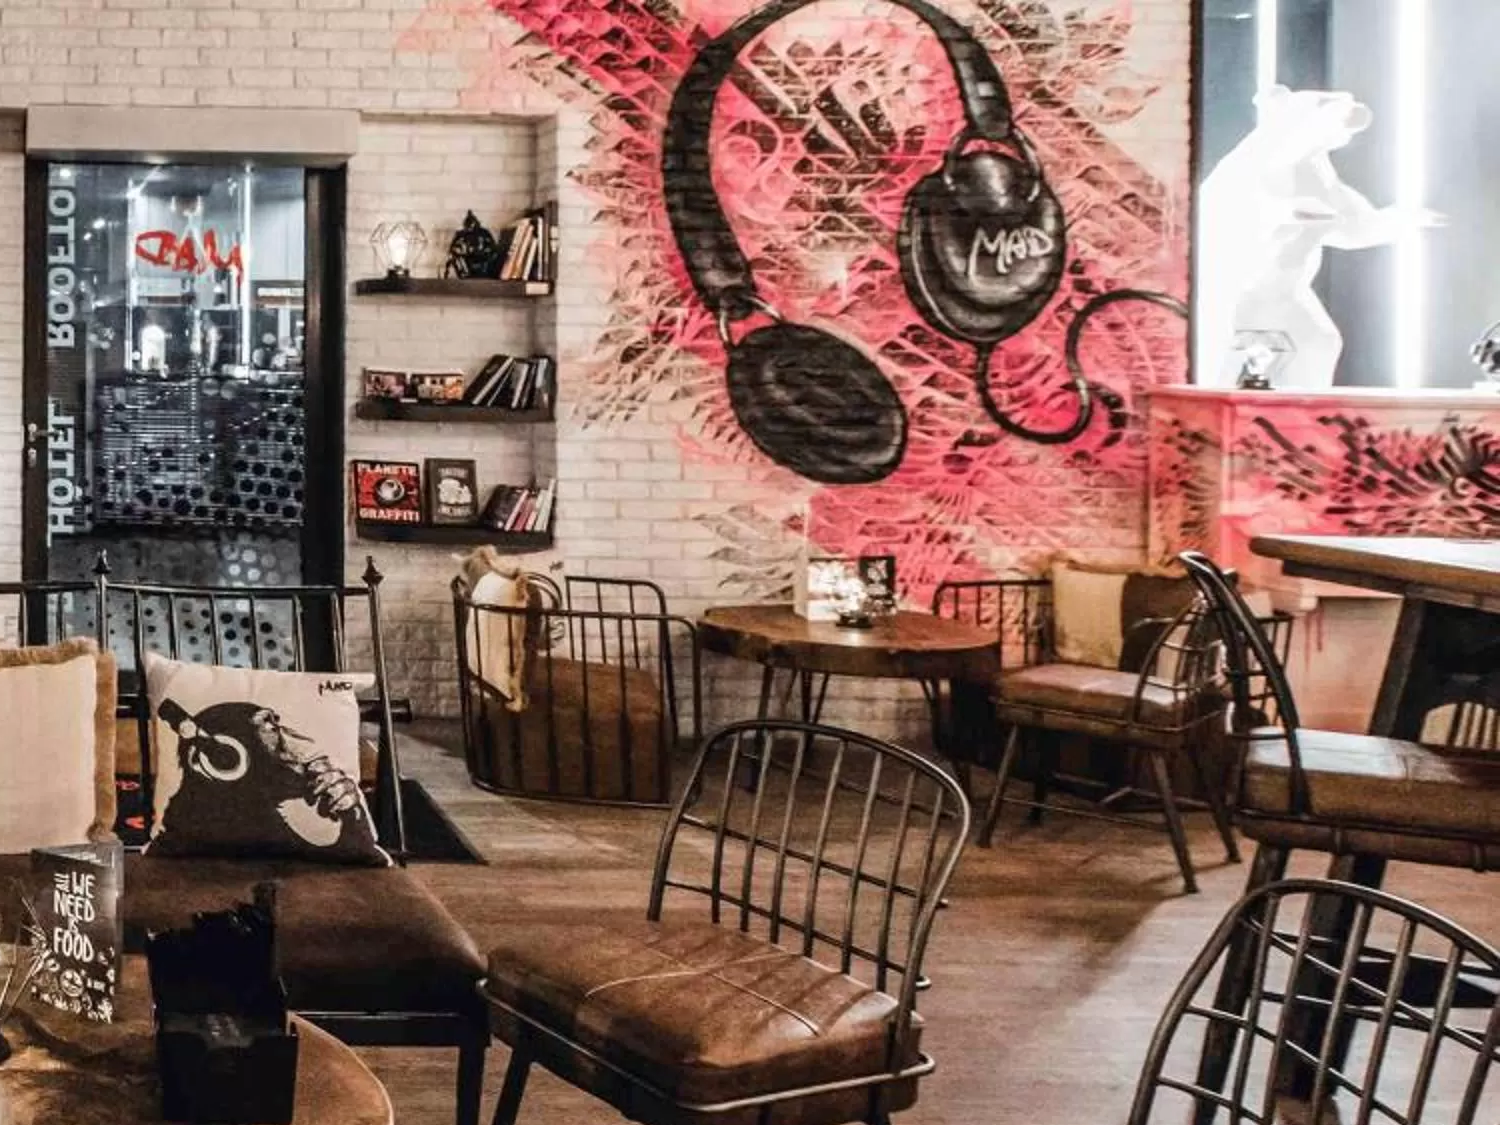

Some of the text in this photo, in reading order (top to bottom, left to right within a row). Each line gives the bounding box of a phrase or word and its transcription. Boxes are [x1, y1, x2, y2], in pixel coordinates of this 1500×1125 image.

[968, 226, 1054, 276] MAD
[359, 507, 420, 522] GRAFFITI
[71, 871, 96, 898] WE
[53, 889, 95, 922] NEED
[53, 927, 95, 962] FOOD
